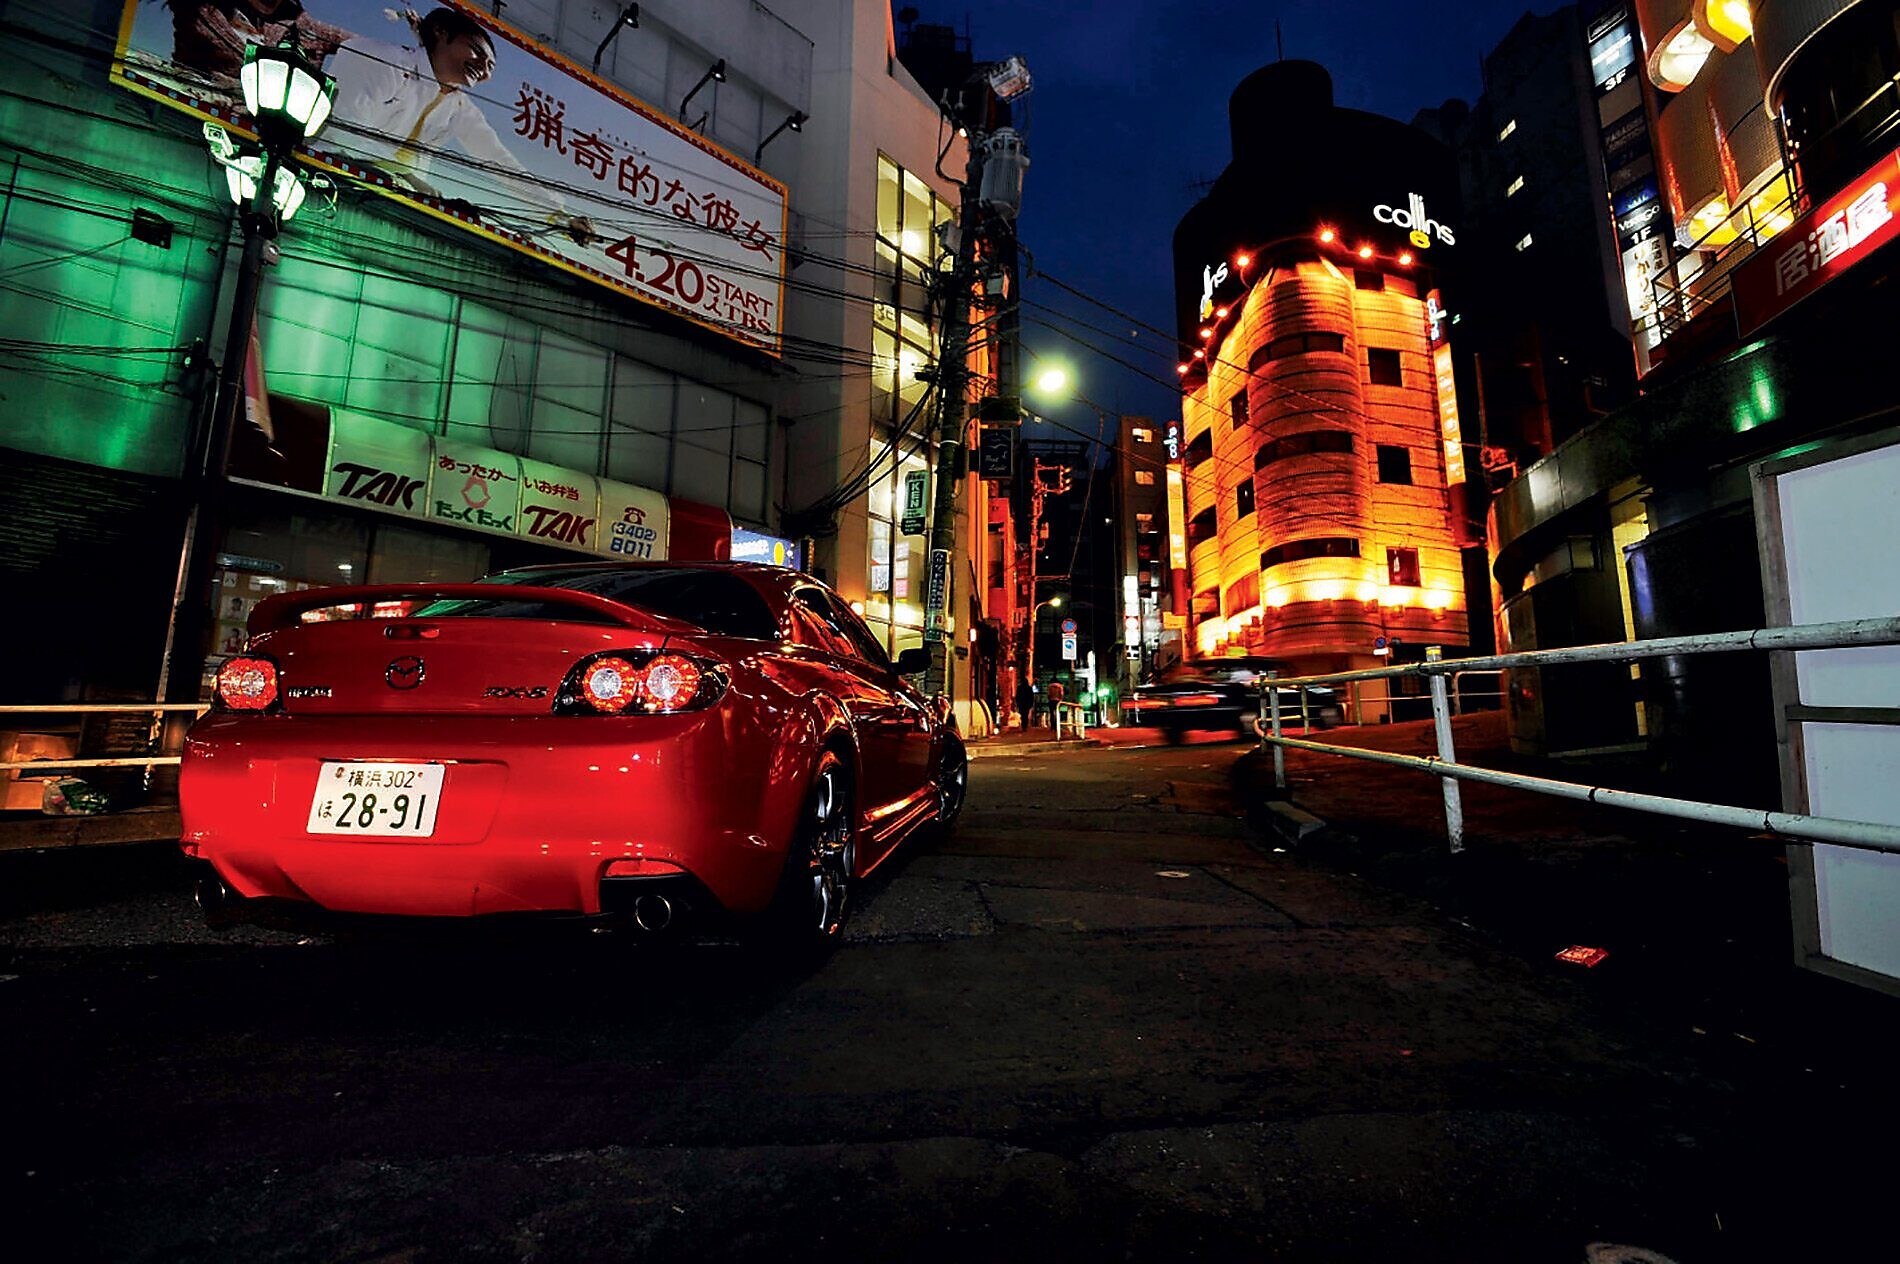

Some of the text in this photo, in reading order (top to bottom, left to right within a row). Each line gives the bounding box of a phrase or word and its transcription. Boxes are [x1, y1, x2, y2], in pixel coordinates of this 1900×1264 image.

[513, 89, 777, 262] 猟奇的な彼女
[1373, 192, 1456, 247] collins
[604, 235, 774, 318] 4.20 START
[724, 302, 772, 336] TBS
[332, 462, 426, 511] TAK
[523, 505, 596, 546] TAK
[610, 537, 652, 559] 8011
[318, 792, 427, 830] ほ 28-91
